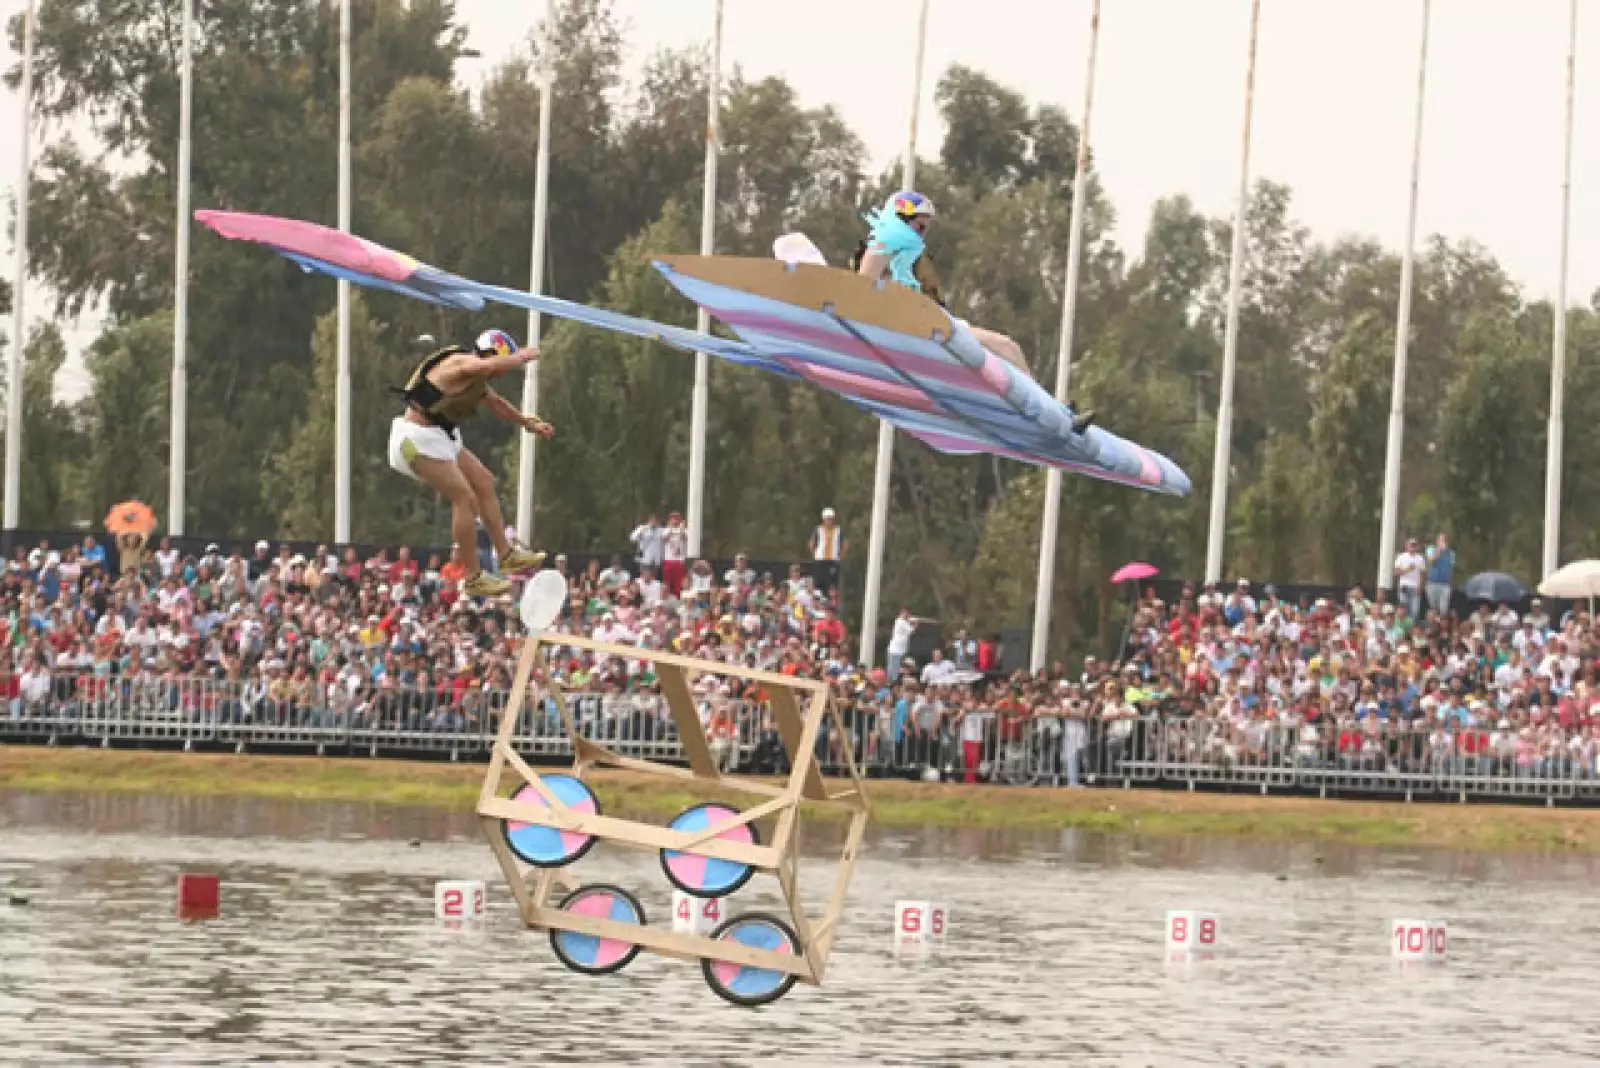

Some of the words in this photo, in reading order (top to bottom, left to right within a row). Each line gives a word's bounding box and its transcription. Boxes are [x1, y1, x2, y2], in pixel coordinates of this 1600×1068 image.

[444, 889, 463, 916] 2
[677, 898, 690, 921] 4
[703, 895, 720, 922] 4
[902, 907, 920, 933] 6
[1172, 917, 1187, 941] 8
[1200, 919, 1215, 944] 8
[1395, 927, 1423, 952] 10
[1428, 927, 1446, 954] 10
